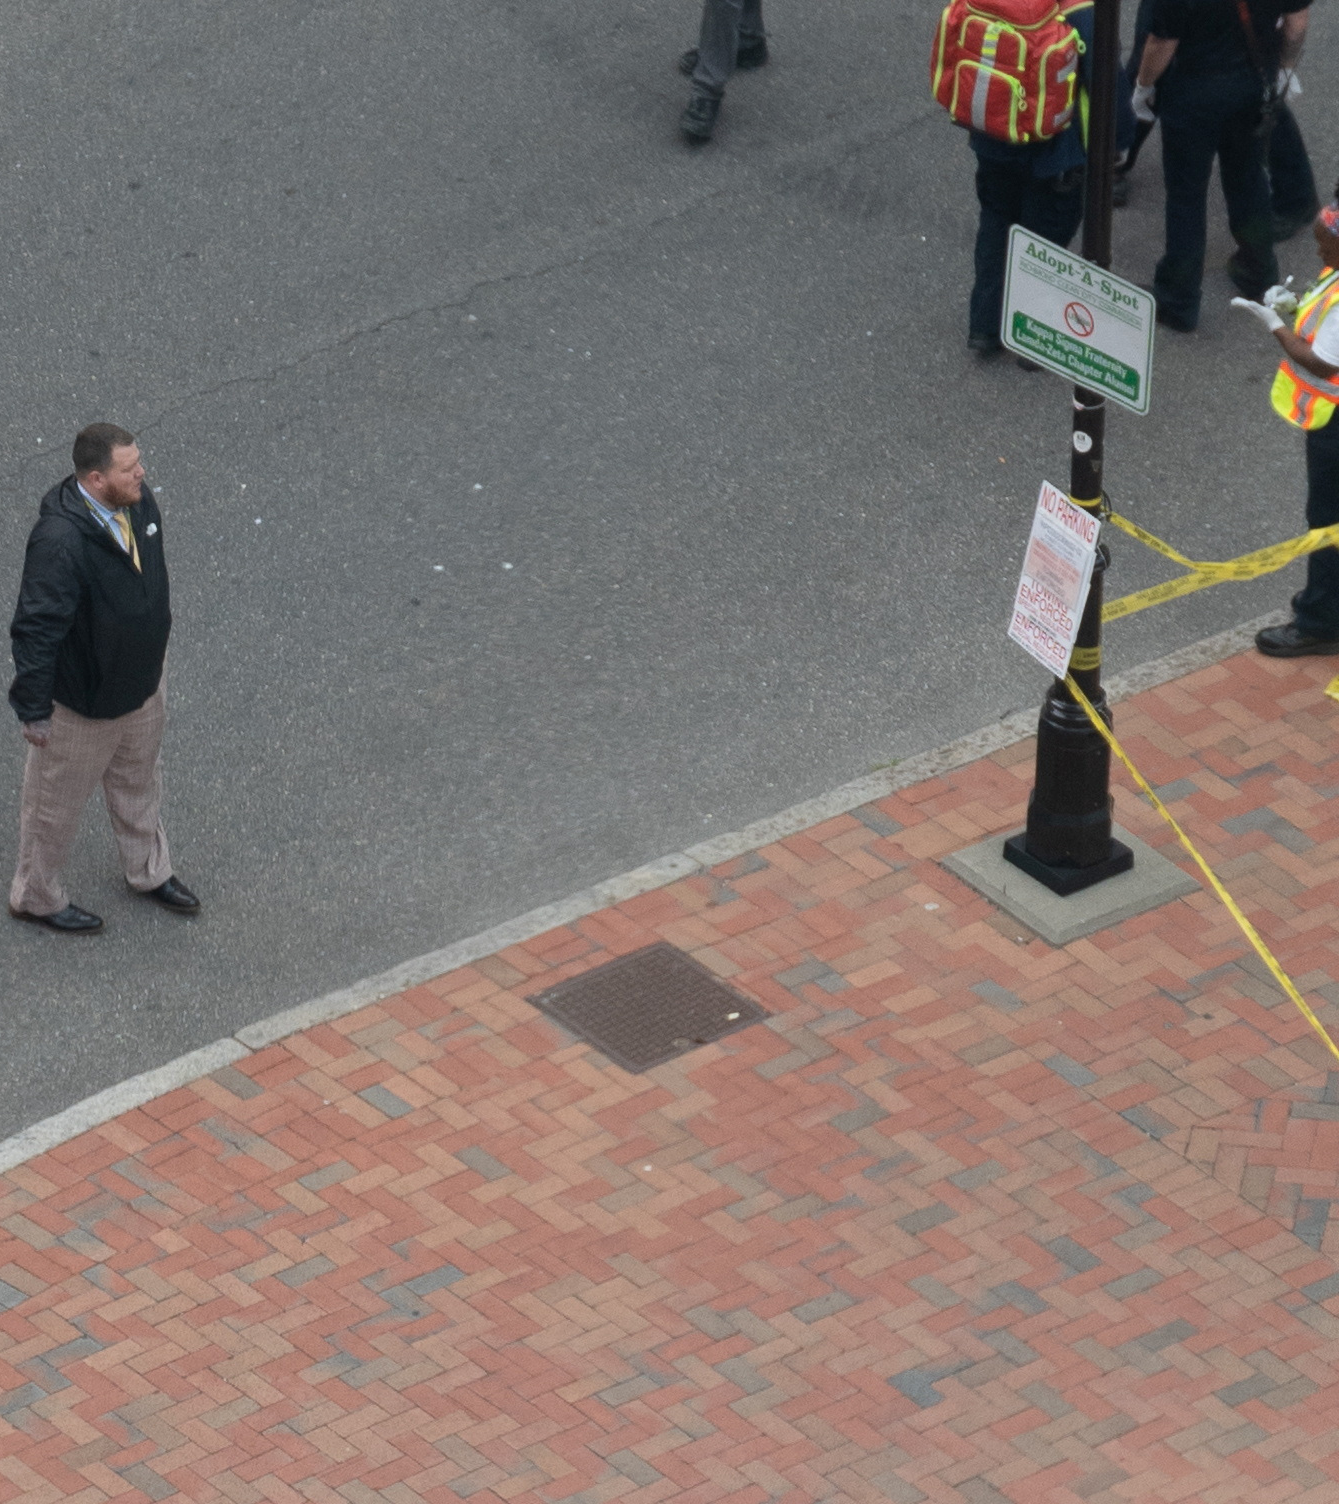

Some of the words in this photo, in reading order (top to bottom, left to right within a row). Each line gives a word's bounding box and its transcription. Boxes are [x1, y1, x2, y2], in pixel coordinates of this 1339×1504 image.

[1024, 238, 1139, 314] Adopt-A-Spot
[1039, 484, 1057, 514] NO
[1054, 496, 1097, 545] PARKING
[1013, 610, 1068, 661] ENFORCED
[1018, 582, 1074, 633] ENFORCED
